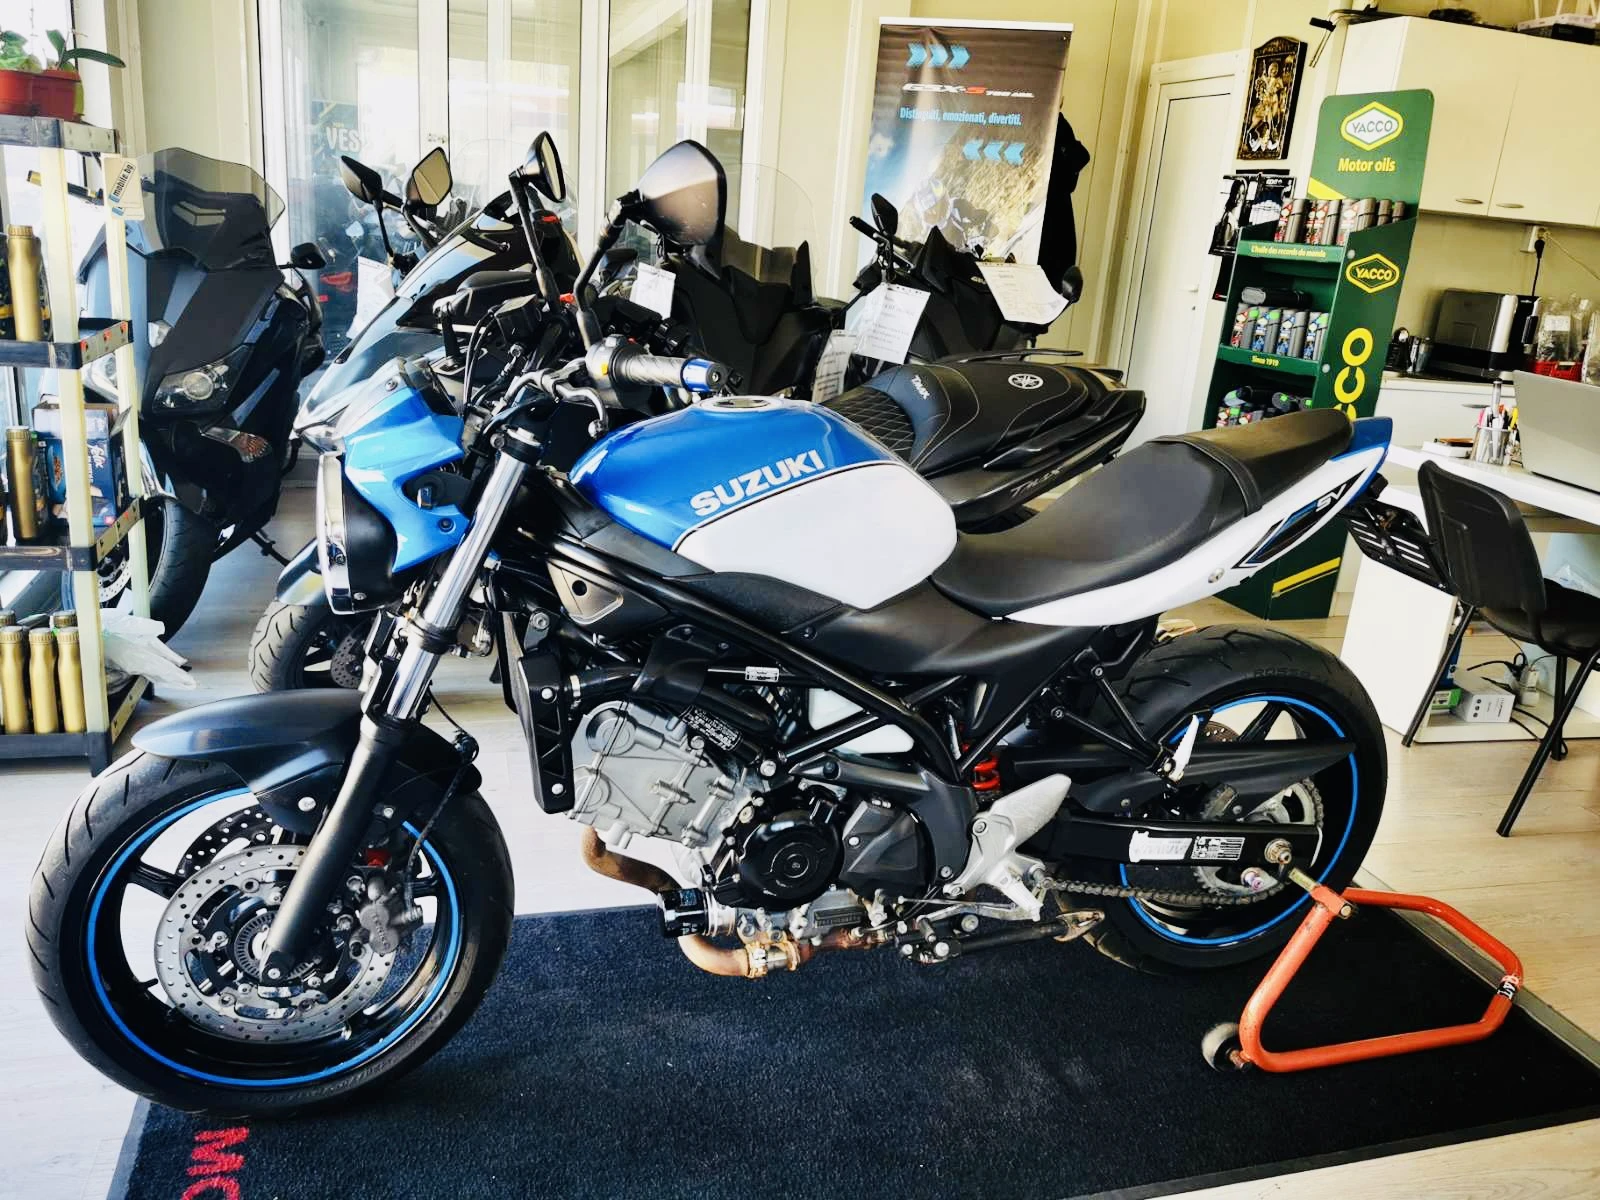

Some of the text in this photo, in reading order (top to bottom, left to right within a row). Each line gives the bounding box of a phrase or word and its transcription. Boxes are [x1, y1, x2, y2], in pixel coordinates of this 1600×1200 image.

[942, 111, 986, 125] emozionati,
[988, 112, 1022, 126] divertiti.
[1352, 120, 1393, 133] YACCO
[1338, 157, 1396, 172] Motor oils
[1355, 267, 1392, 281] YACCO
[690, 449, 825, 516] SUZUKI
[1316, 483, 1347, 512] SV
